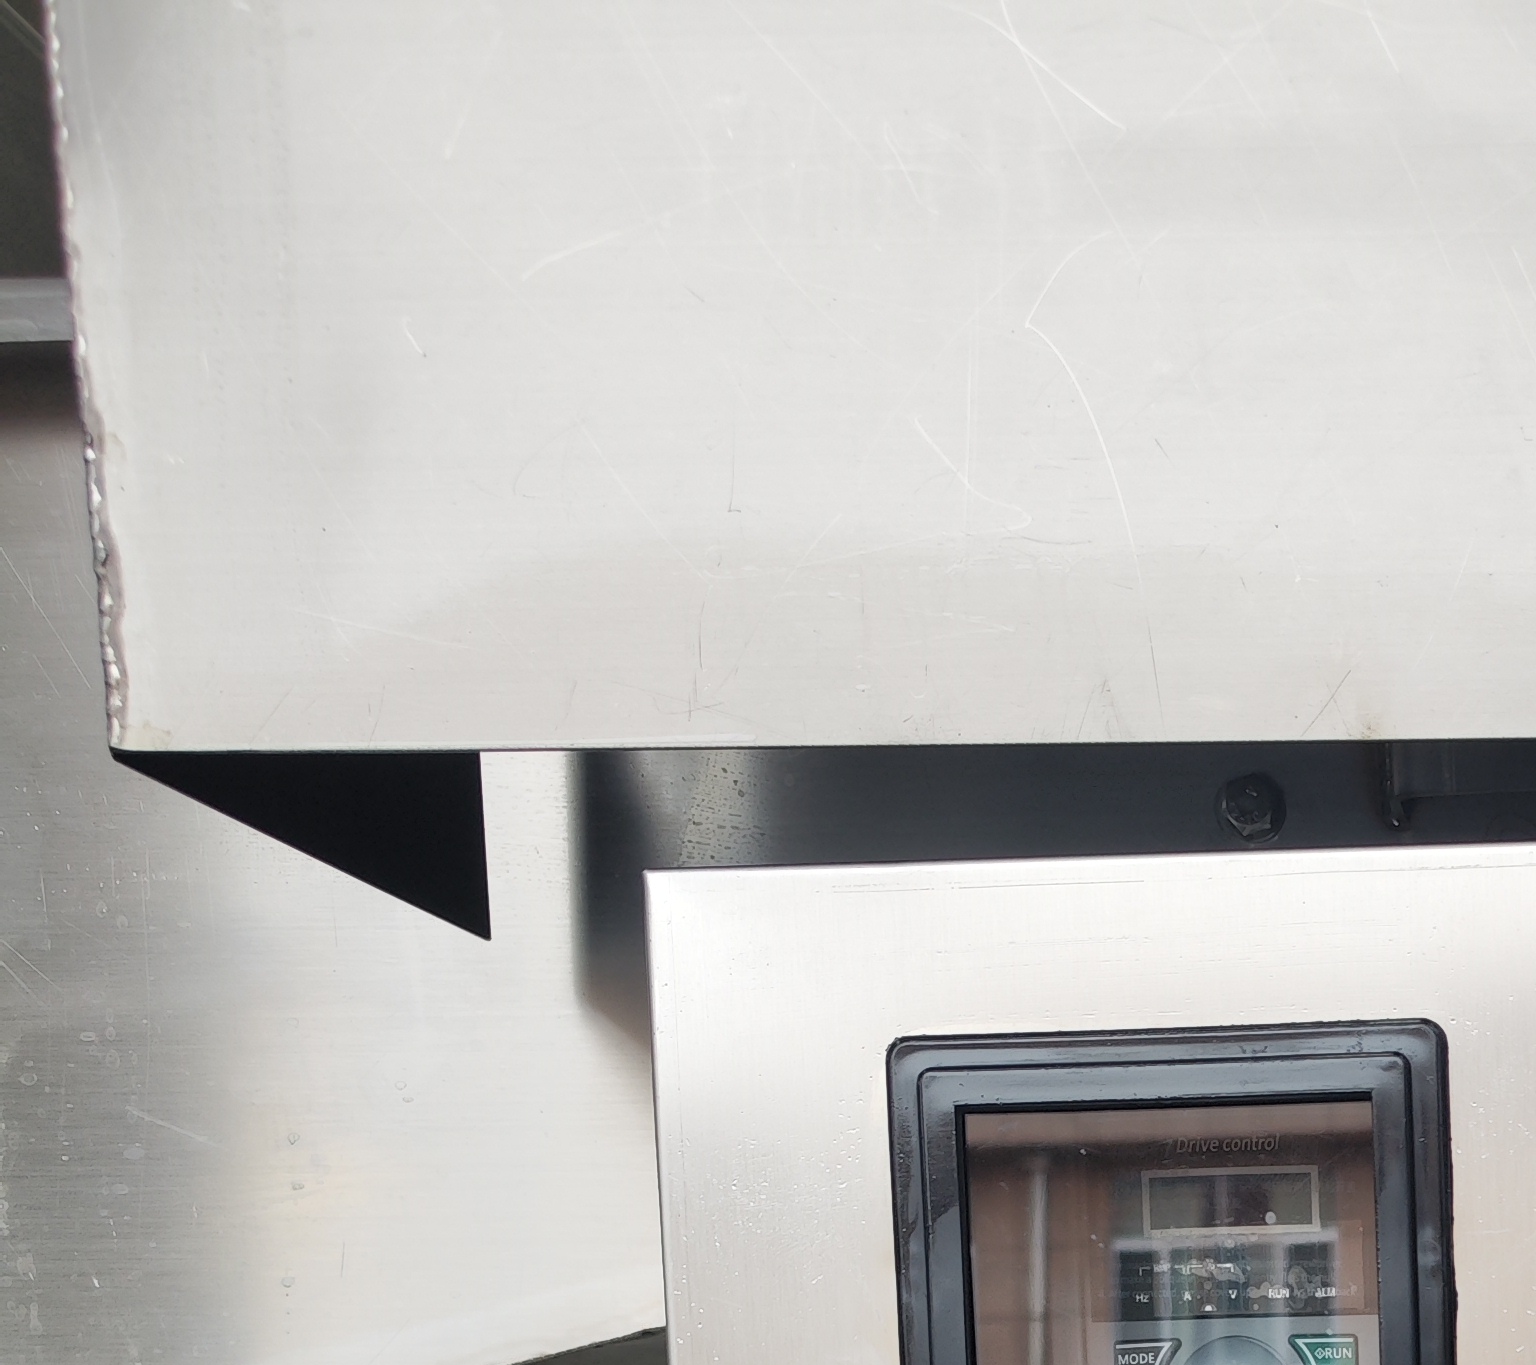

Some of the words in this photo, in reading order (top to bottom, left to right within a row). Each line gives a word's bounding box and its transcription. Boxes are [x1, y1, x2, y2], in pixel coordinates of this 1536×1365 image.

[1176, 1136, 1219, 1154] Drive
[1222, 1133, 1281, 1152] control
[1135, 1293, 1149, 1303] Hz
[1268, 1287, 1290, 1298] RUN
[1117, 1353, 1155, 1365] MODE
[1324, 1347, 1352, 1359] RUN
